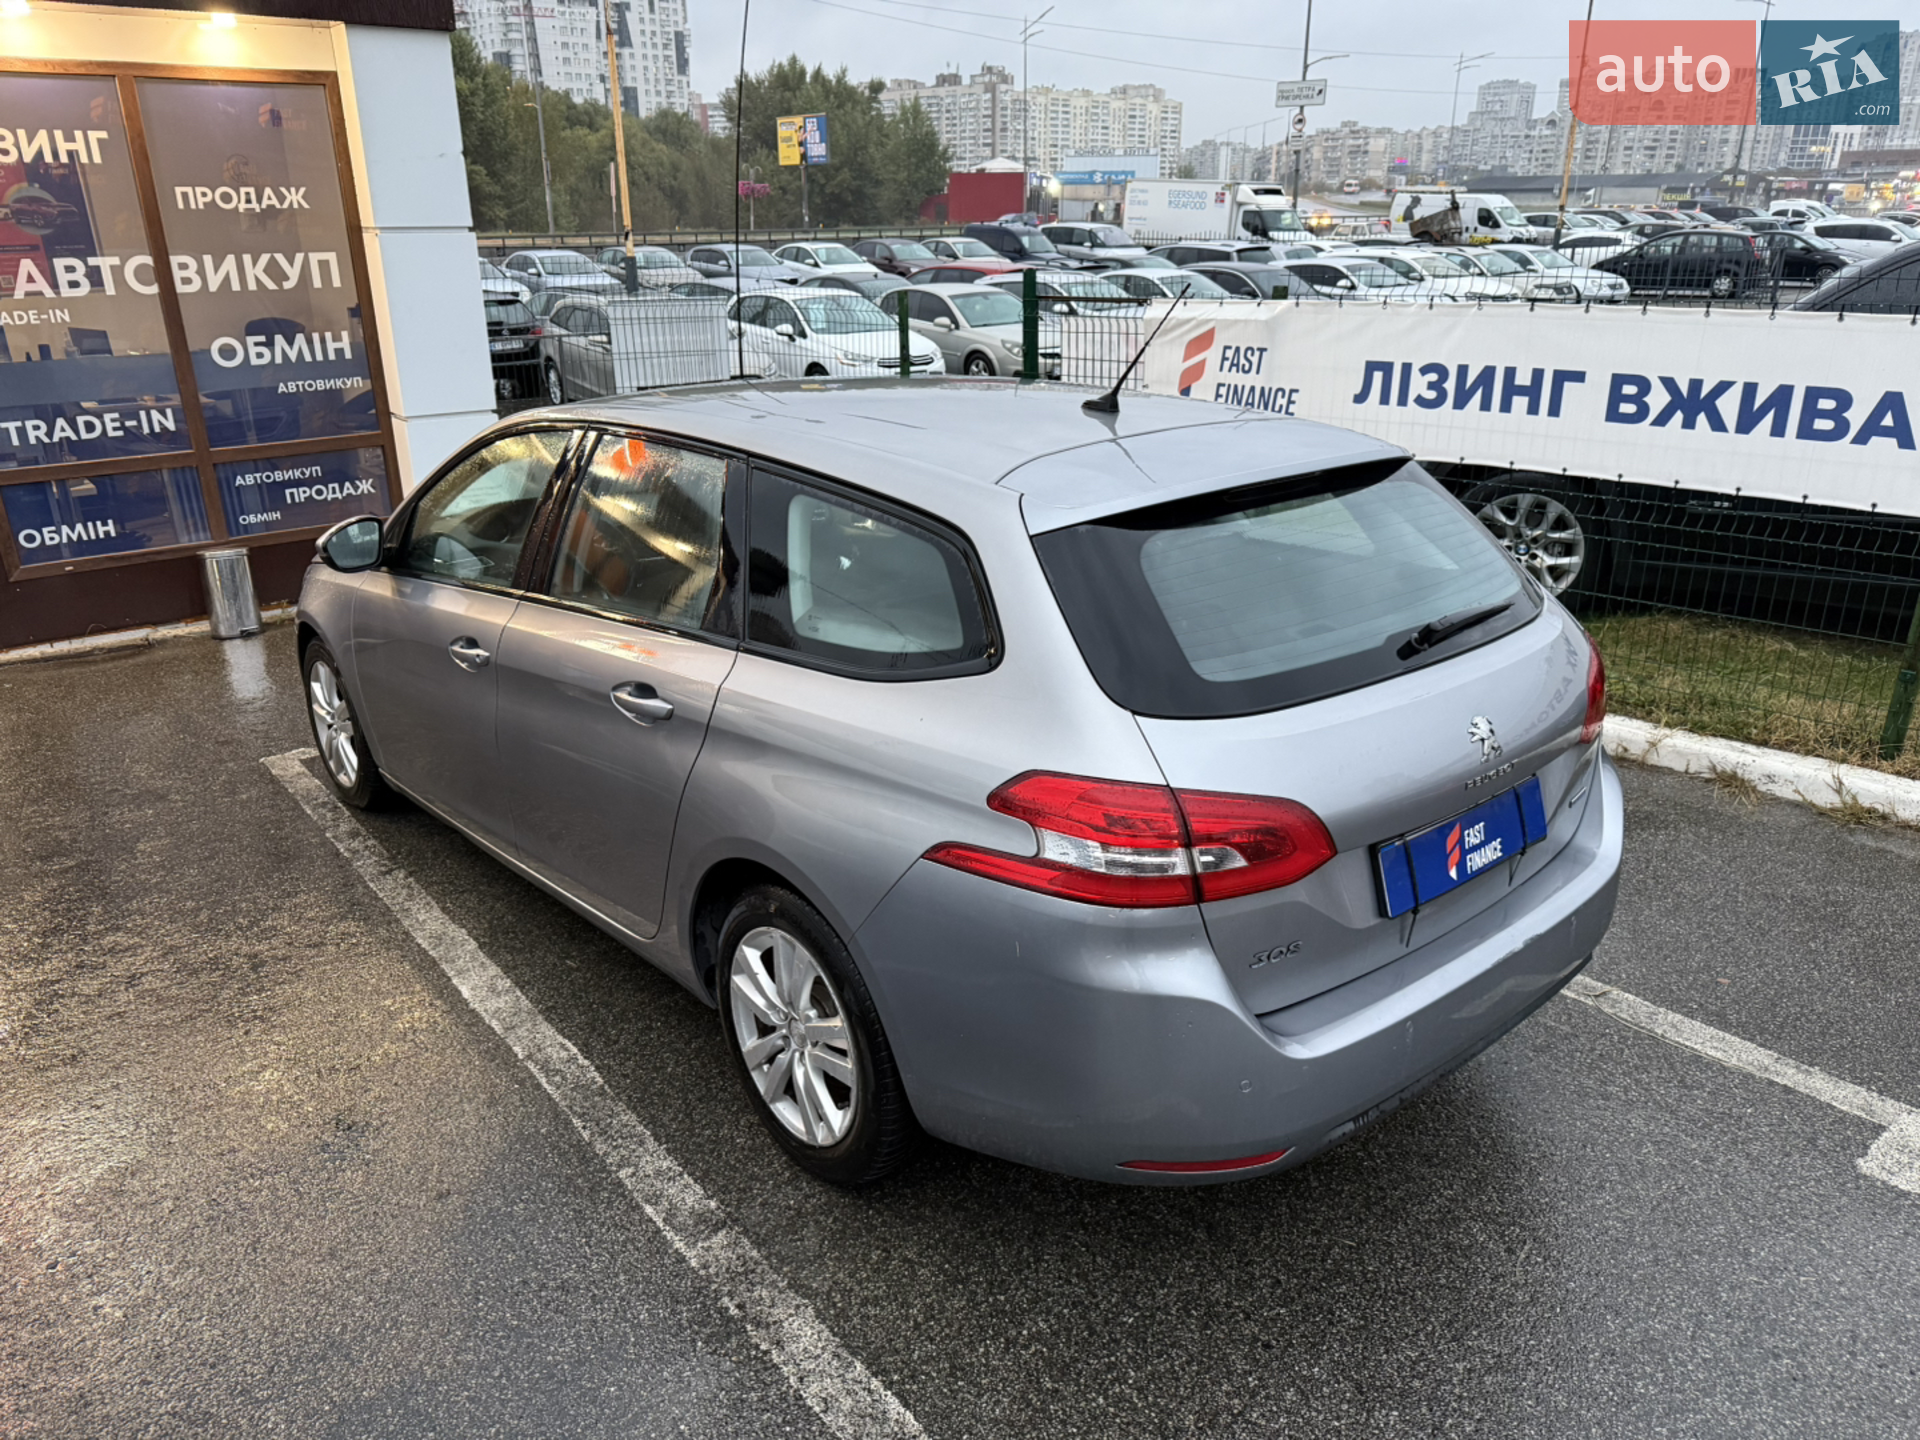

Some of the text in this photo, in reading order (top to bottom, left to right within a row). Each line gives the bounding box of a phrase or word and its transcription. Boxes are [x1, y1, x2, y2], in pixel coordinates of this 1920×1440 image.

[174, 186, 310, 213] ПРОДАЖ
[1168, 189, 1207, 200] EGERSUND
[210, 331, 353, 368] ОБМІН
[1219, 345, 1267, 375] FAST
[277, 376, 363, 394] АВТОВИКУП
[1214, 383, 1299, 416] FINANCE
[1353, 360, 1917, 450] ЛІЗИНГ ВЖИВА
[1, 408, 177, 447] TRADE-IN
[234, 465, 323, 487] АВТОВИКУП
[285, 479, 377, 504] ПРОДАЖ
[238, 511, 281, 525] ОБМІН
[18, 519, 117, 549] ОБМІН
[1464, 822, 1485, 850] FAST
[1466, 838, 1503, 874] FINANCE
